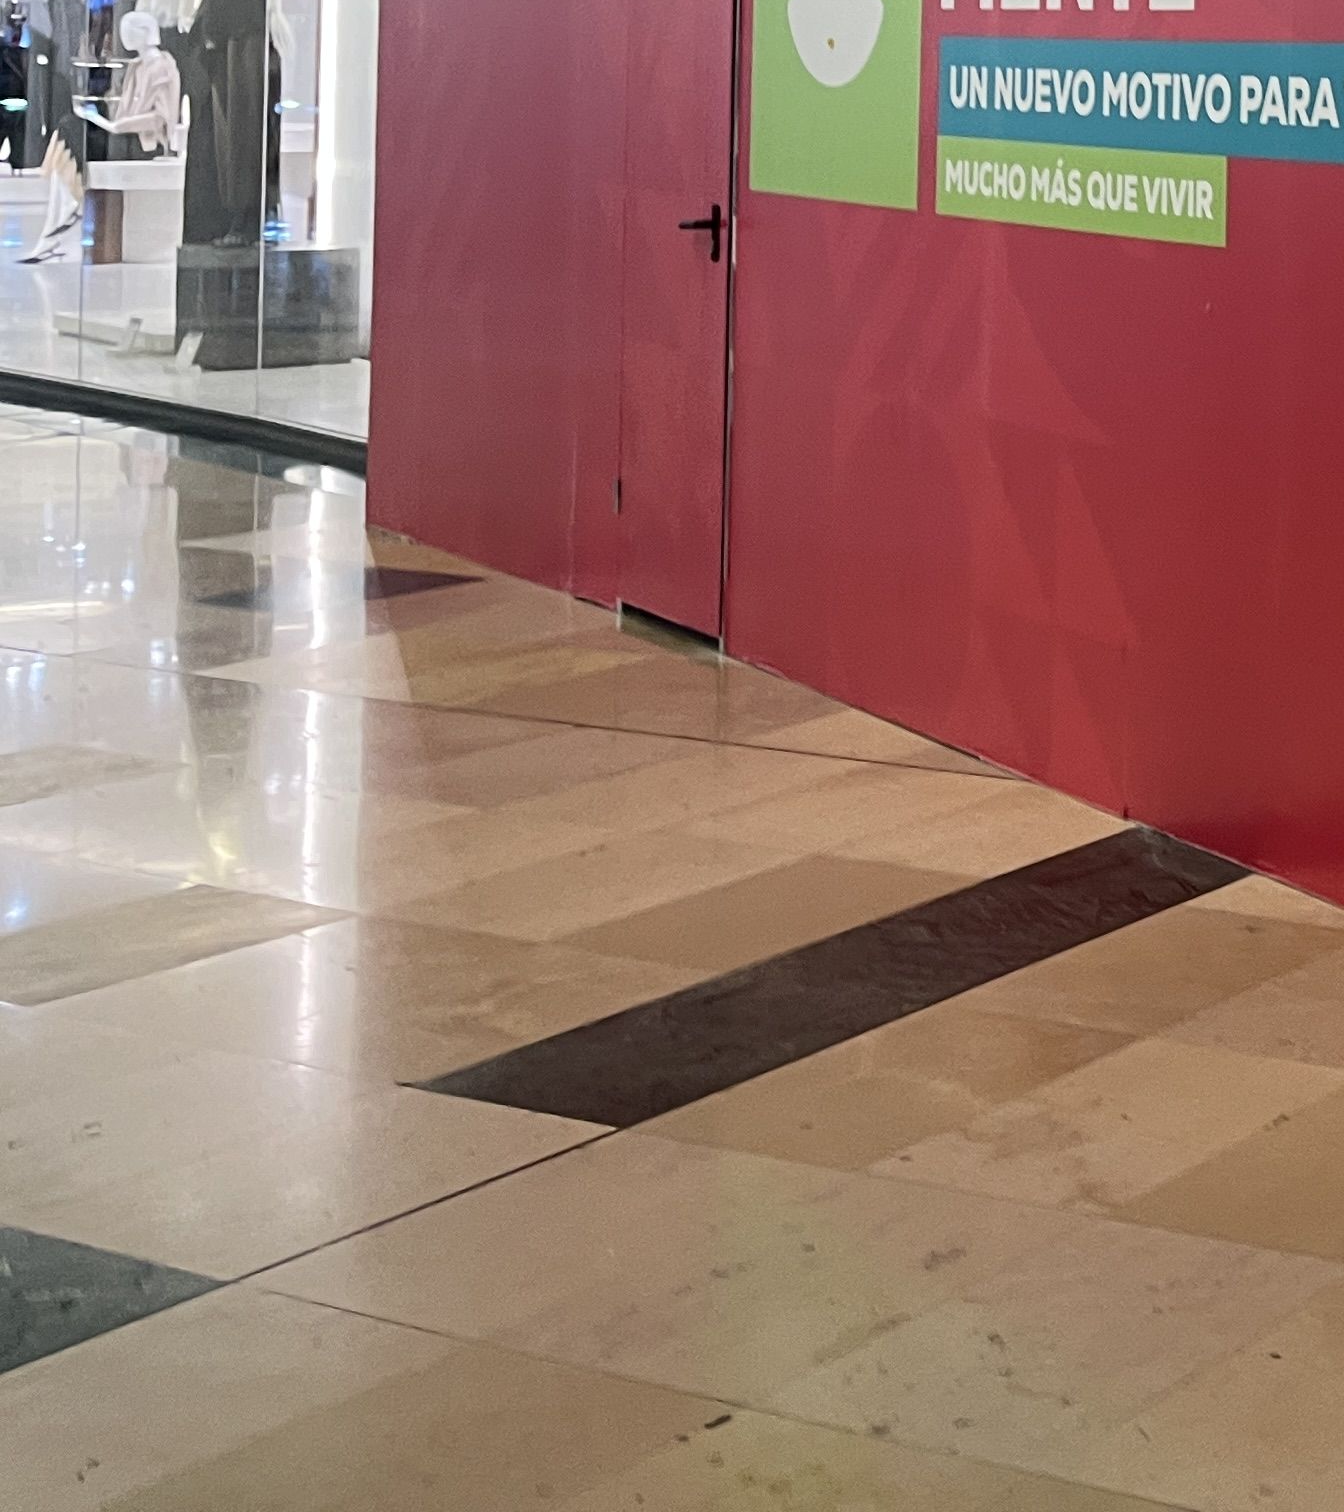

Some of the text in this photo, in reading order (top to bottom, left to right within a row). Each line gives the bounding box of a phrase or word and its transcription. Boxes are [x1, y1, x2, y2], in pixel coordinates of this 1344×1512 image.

[949, 64, 988, 110] UN
[993, 66, 1096, 117] NUEVO
[1101, 70, 1231, 124] MOTIVO
[1239, 74, 1341, 129] PARA
[944, 157, 1214, 220] MUCHO MÁS QUE VIVIR
